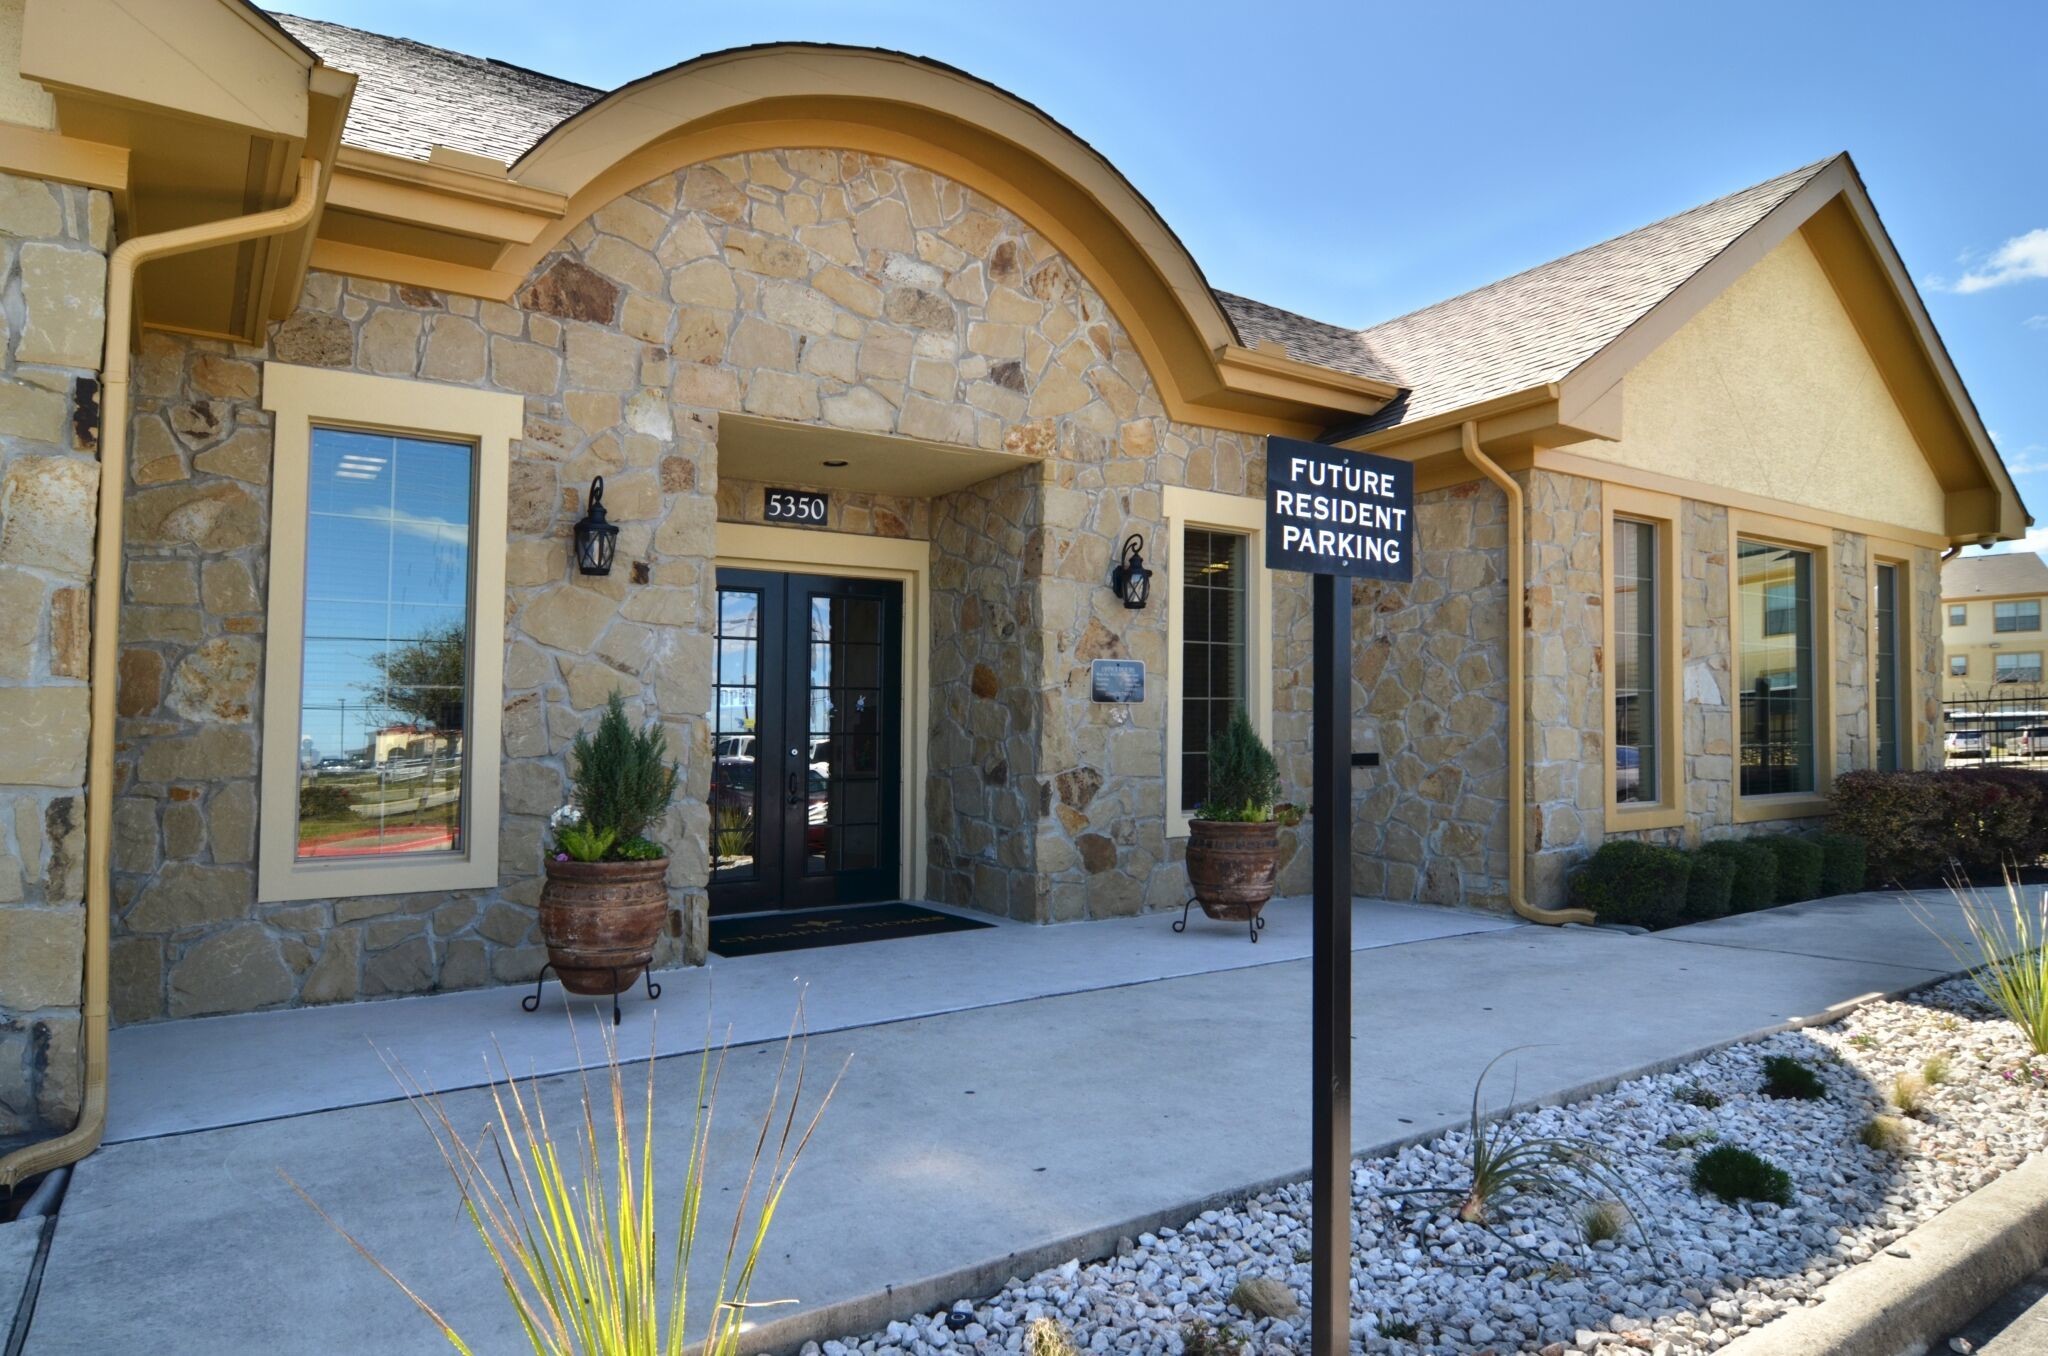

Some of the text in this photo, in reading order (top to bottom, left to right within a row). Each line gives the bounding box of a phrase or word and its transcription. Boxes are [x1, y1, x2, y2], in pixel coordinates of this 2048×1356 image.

[1291, 457, 1395, 498] FUTURE
[768, 494, 825, 520] 5350
[1276, 489, 1406, 531] RESIDENT
[1283, 525, 1400, 564] PARKING
